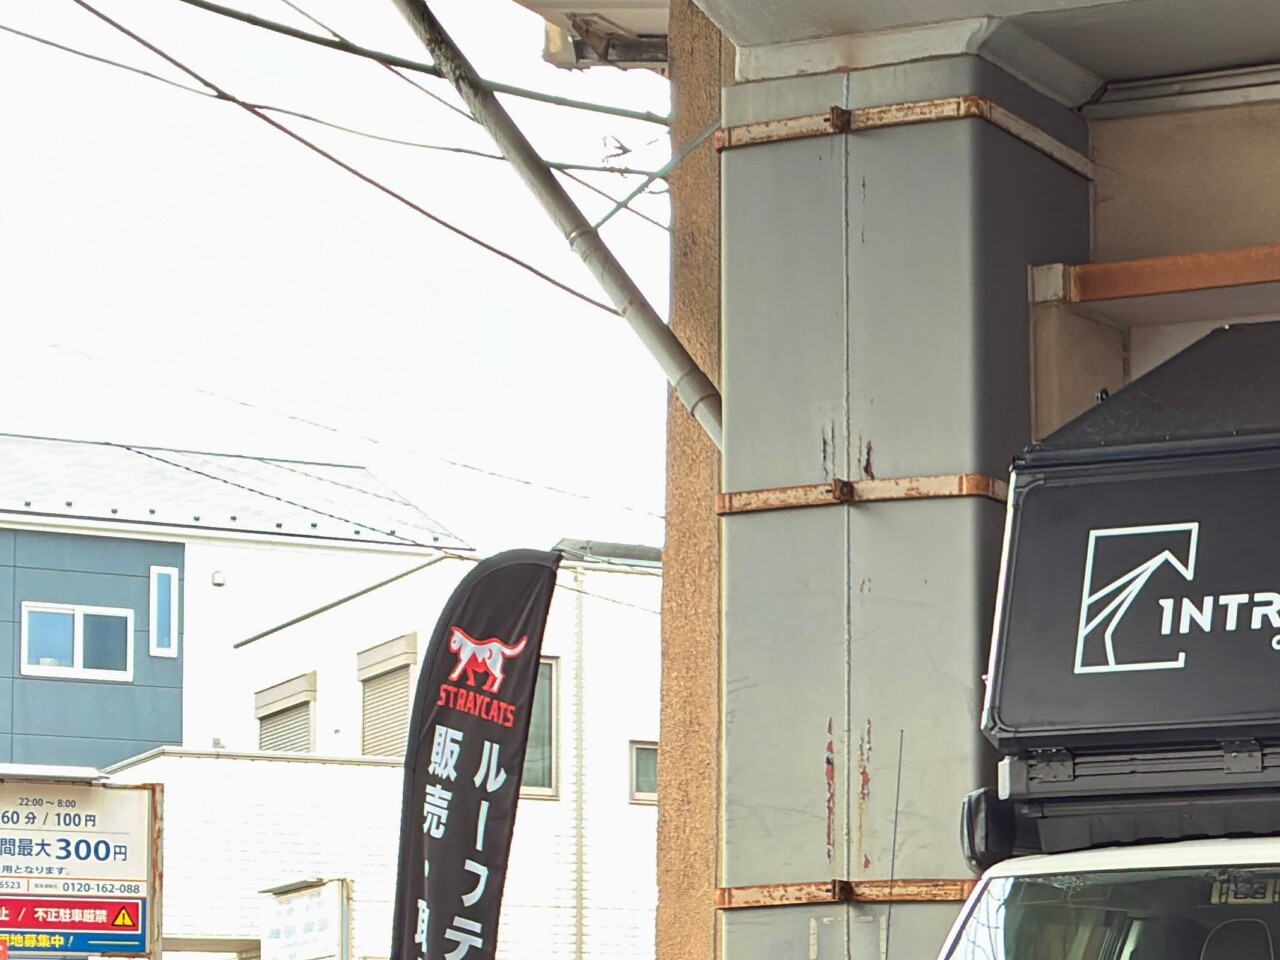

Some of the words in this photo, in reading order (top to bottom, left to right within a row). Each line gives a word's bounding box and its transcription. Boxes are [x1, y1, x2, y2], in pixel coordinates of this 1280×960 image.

[437, 684, 516, 728] STRAYCATS
[18, 797, 43, 807] 22:00
[57, 799, 76, 808] 8:00
[62, 882, 140, 894] 0120-162-088
